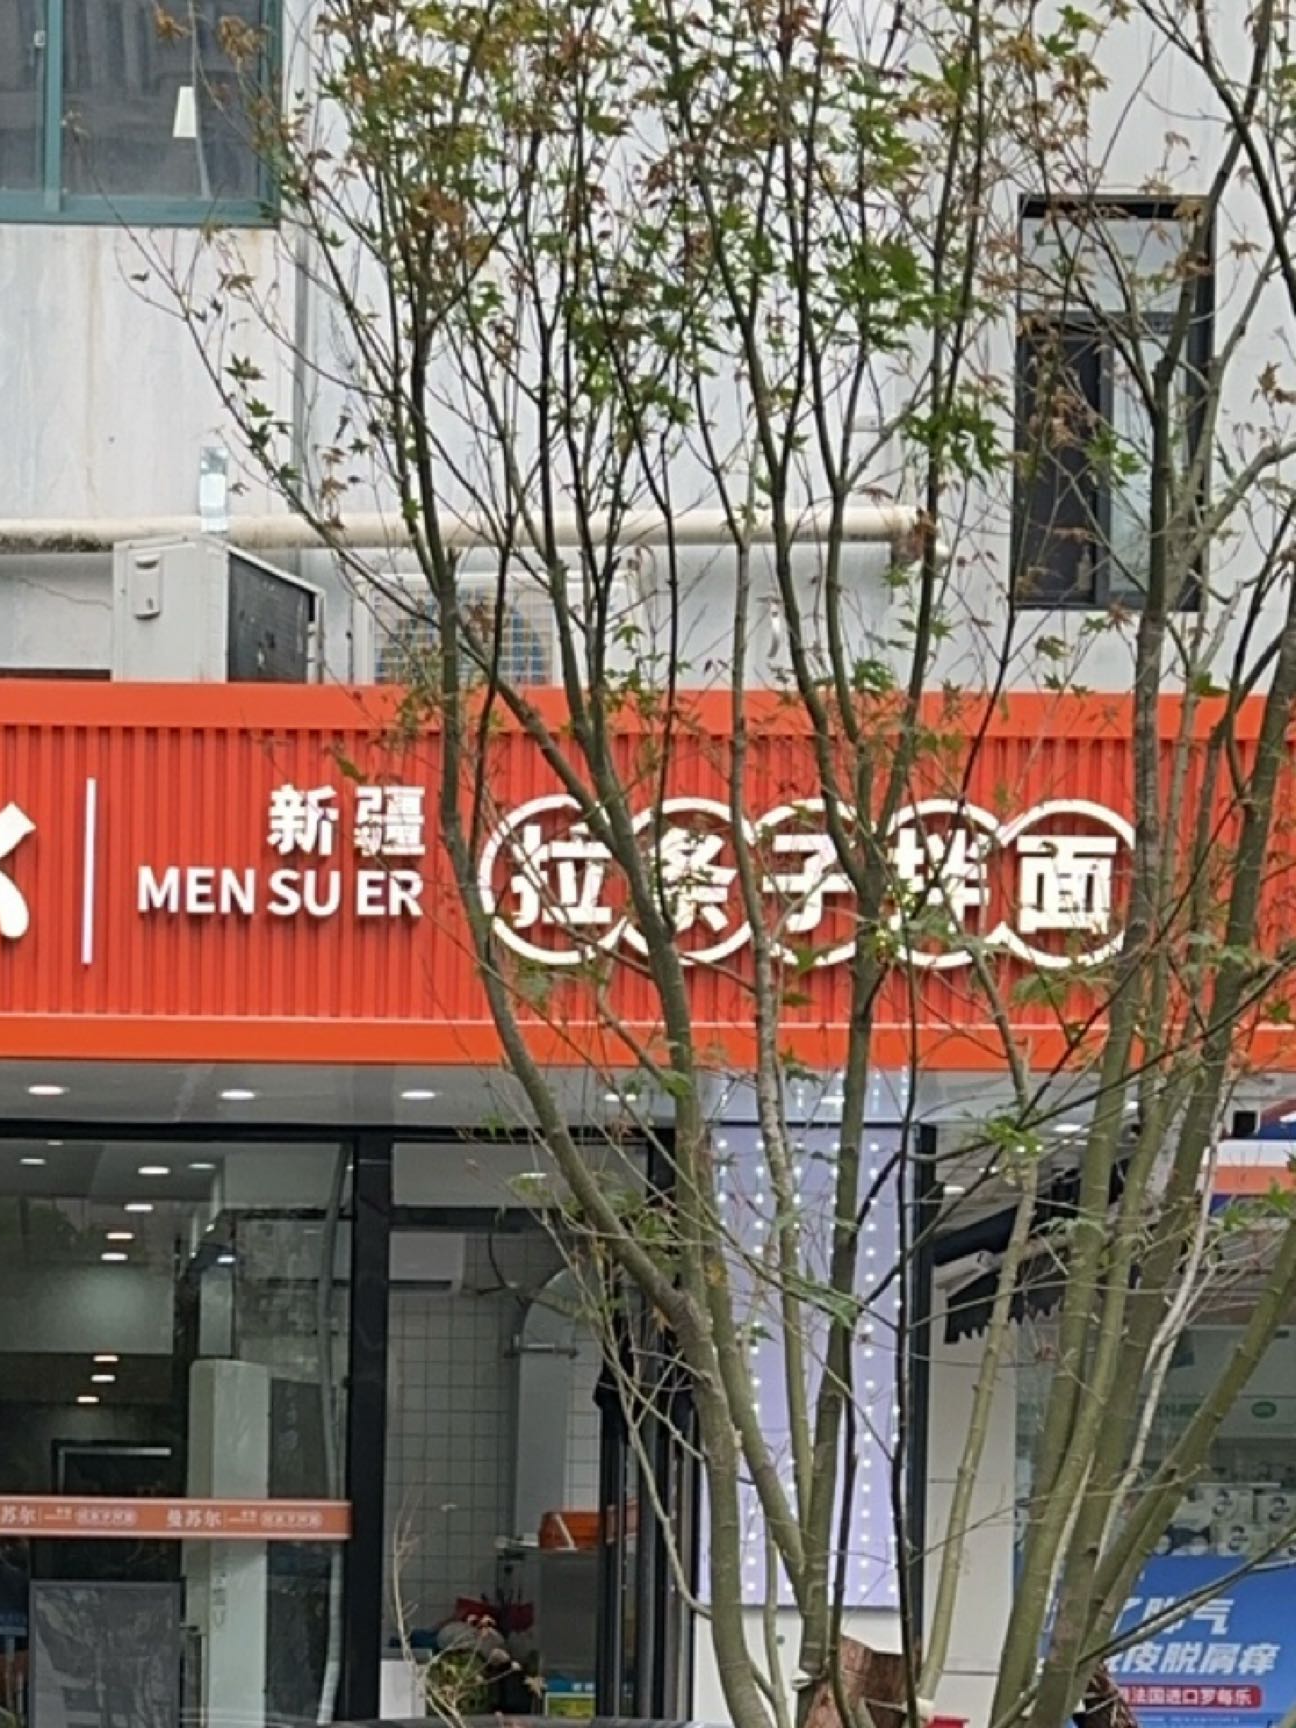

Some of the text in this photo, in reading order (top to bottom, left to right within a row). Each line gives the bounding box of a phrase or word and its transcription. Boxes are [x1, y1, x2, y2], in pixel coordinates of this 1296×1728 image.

[266, 781, 426, 858] 新疆
[136, 865, 424, 917] MEN SU ER
[511, 825, 1118, 936] 拉条子拌面
